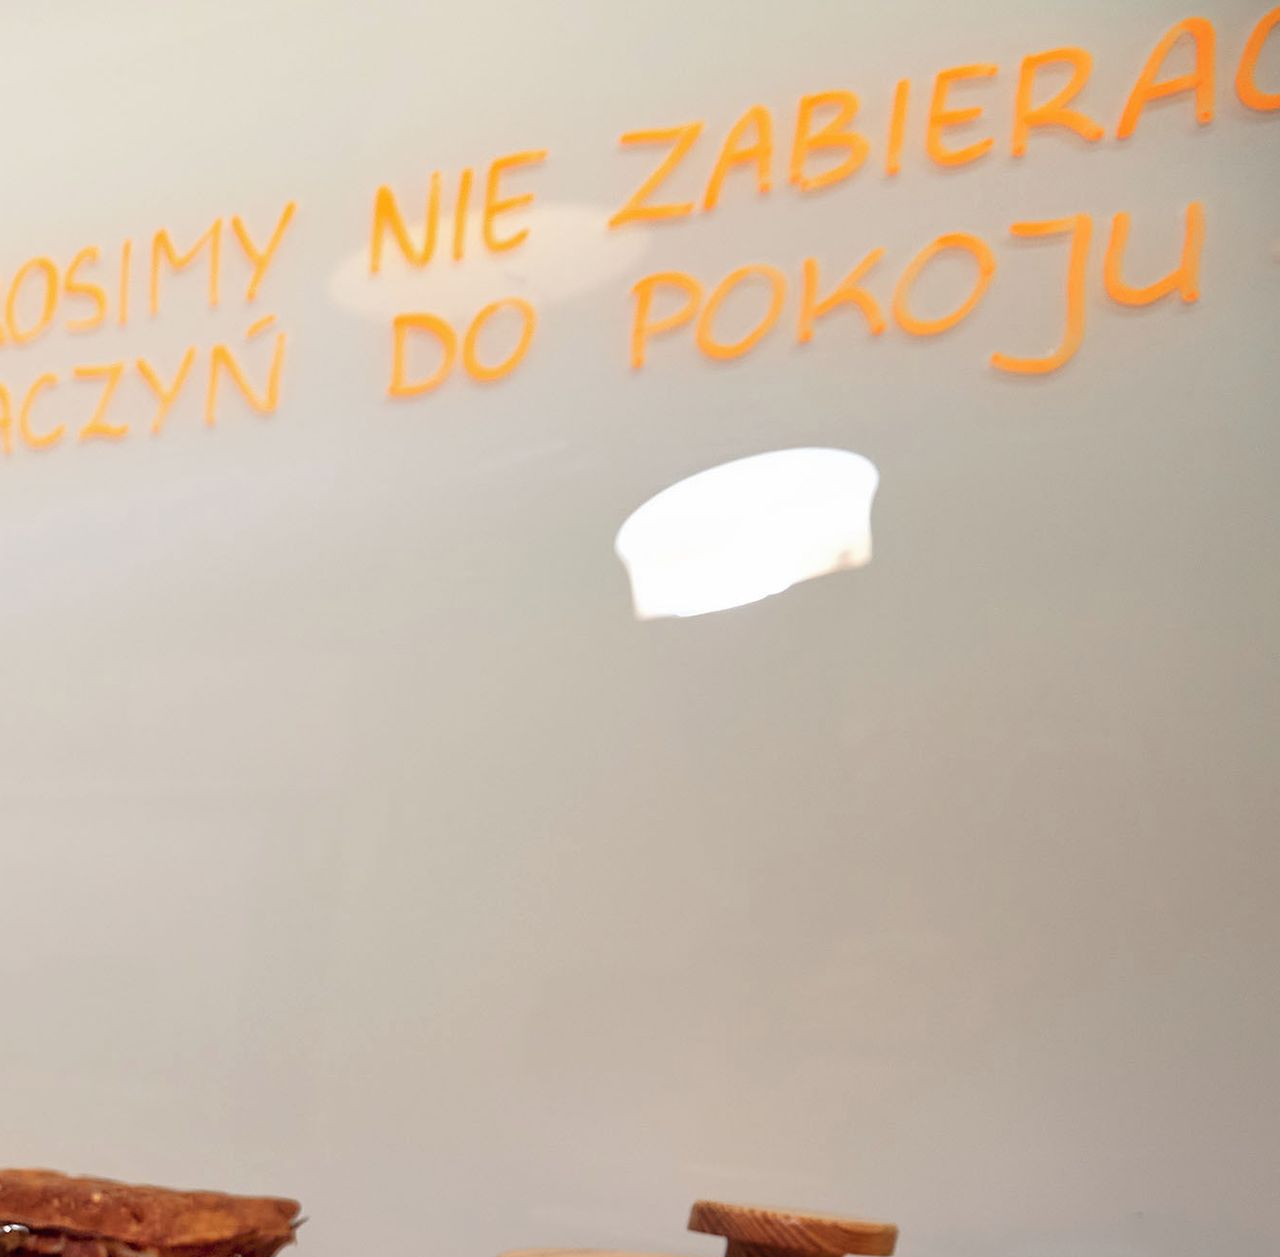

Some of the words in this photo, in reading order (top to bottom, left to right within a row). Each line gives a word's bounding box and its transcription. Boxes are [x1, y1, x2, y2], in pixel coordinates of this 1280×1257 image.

[368, 148, 549, 275] NIE
[386, 296, 538, 399] DO
[629, 201, 1206, 376] POKOJU
